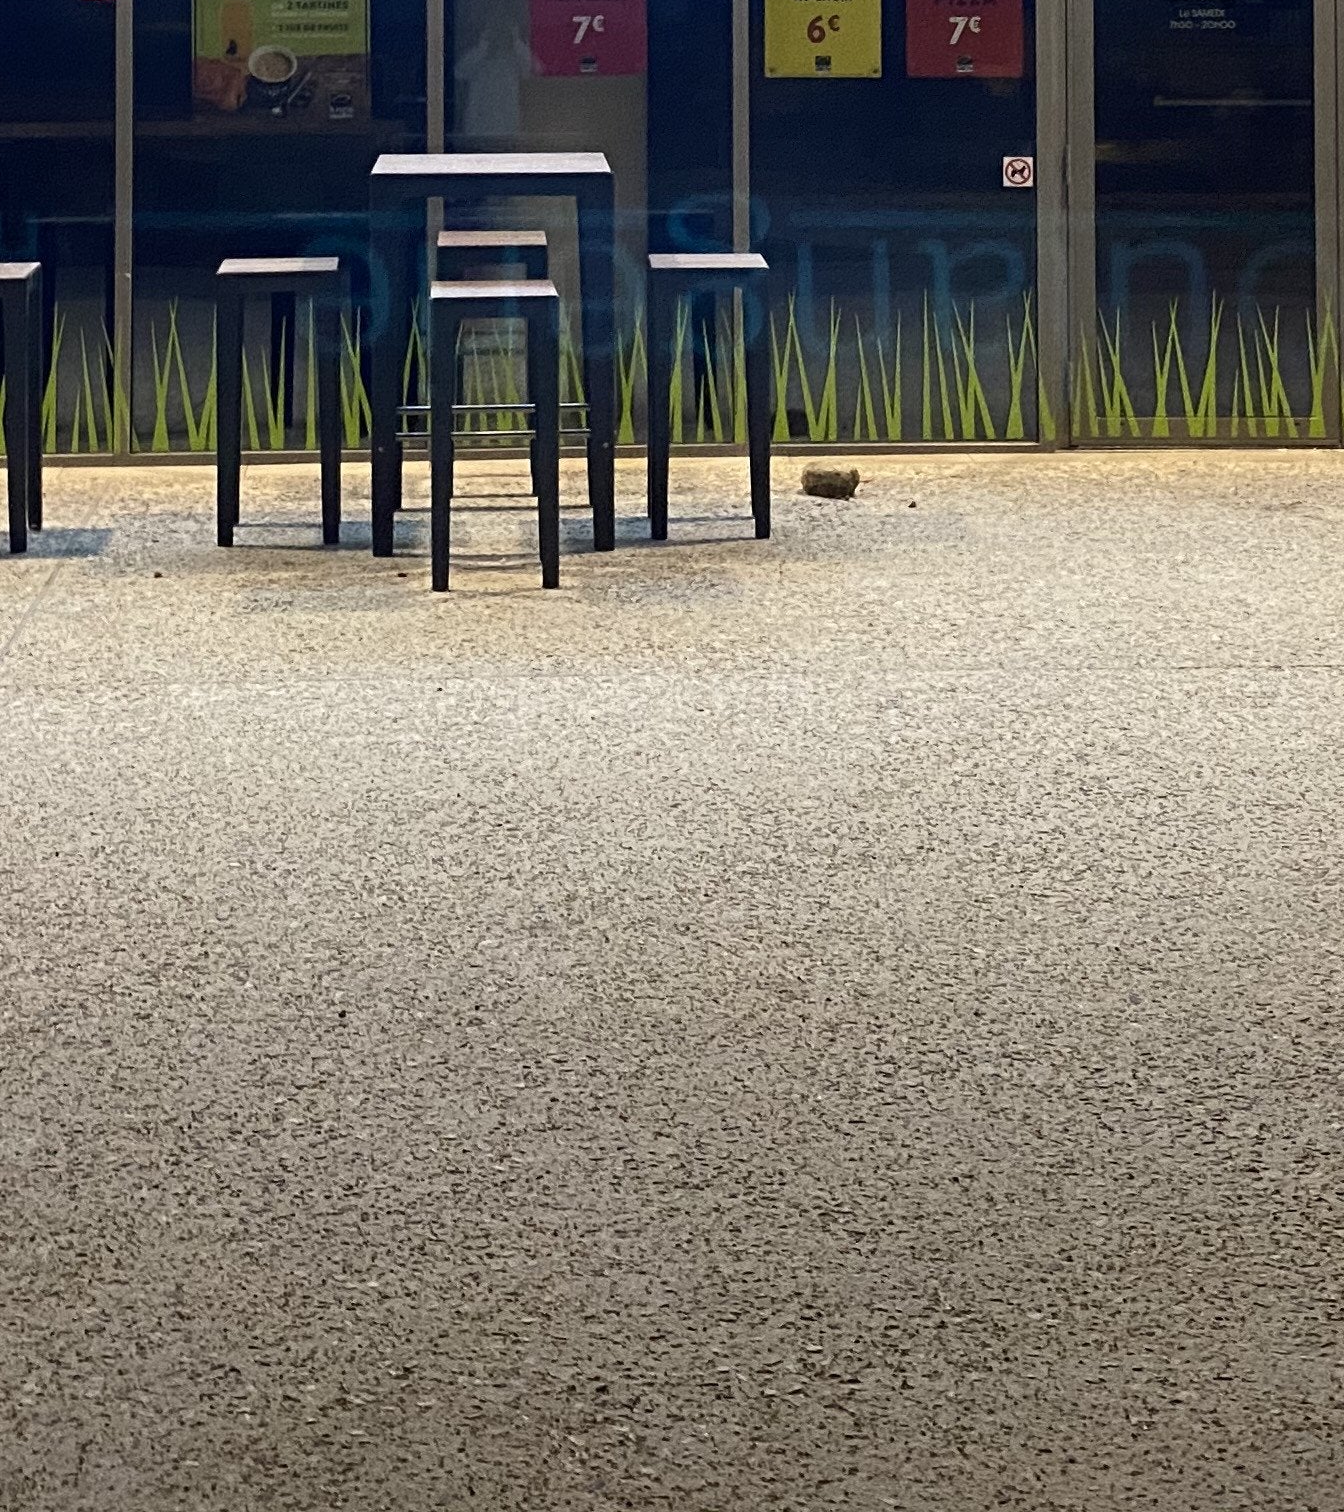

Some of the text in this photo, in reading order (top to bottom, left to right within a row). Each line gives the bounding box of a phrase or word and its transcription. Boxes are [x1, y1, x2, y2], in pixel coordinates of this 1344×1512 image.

[572, 15, 605, 44] 7€
[807, 15, 840, 43] 6€
[949, 15, 981, 44] 7€
